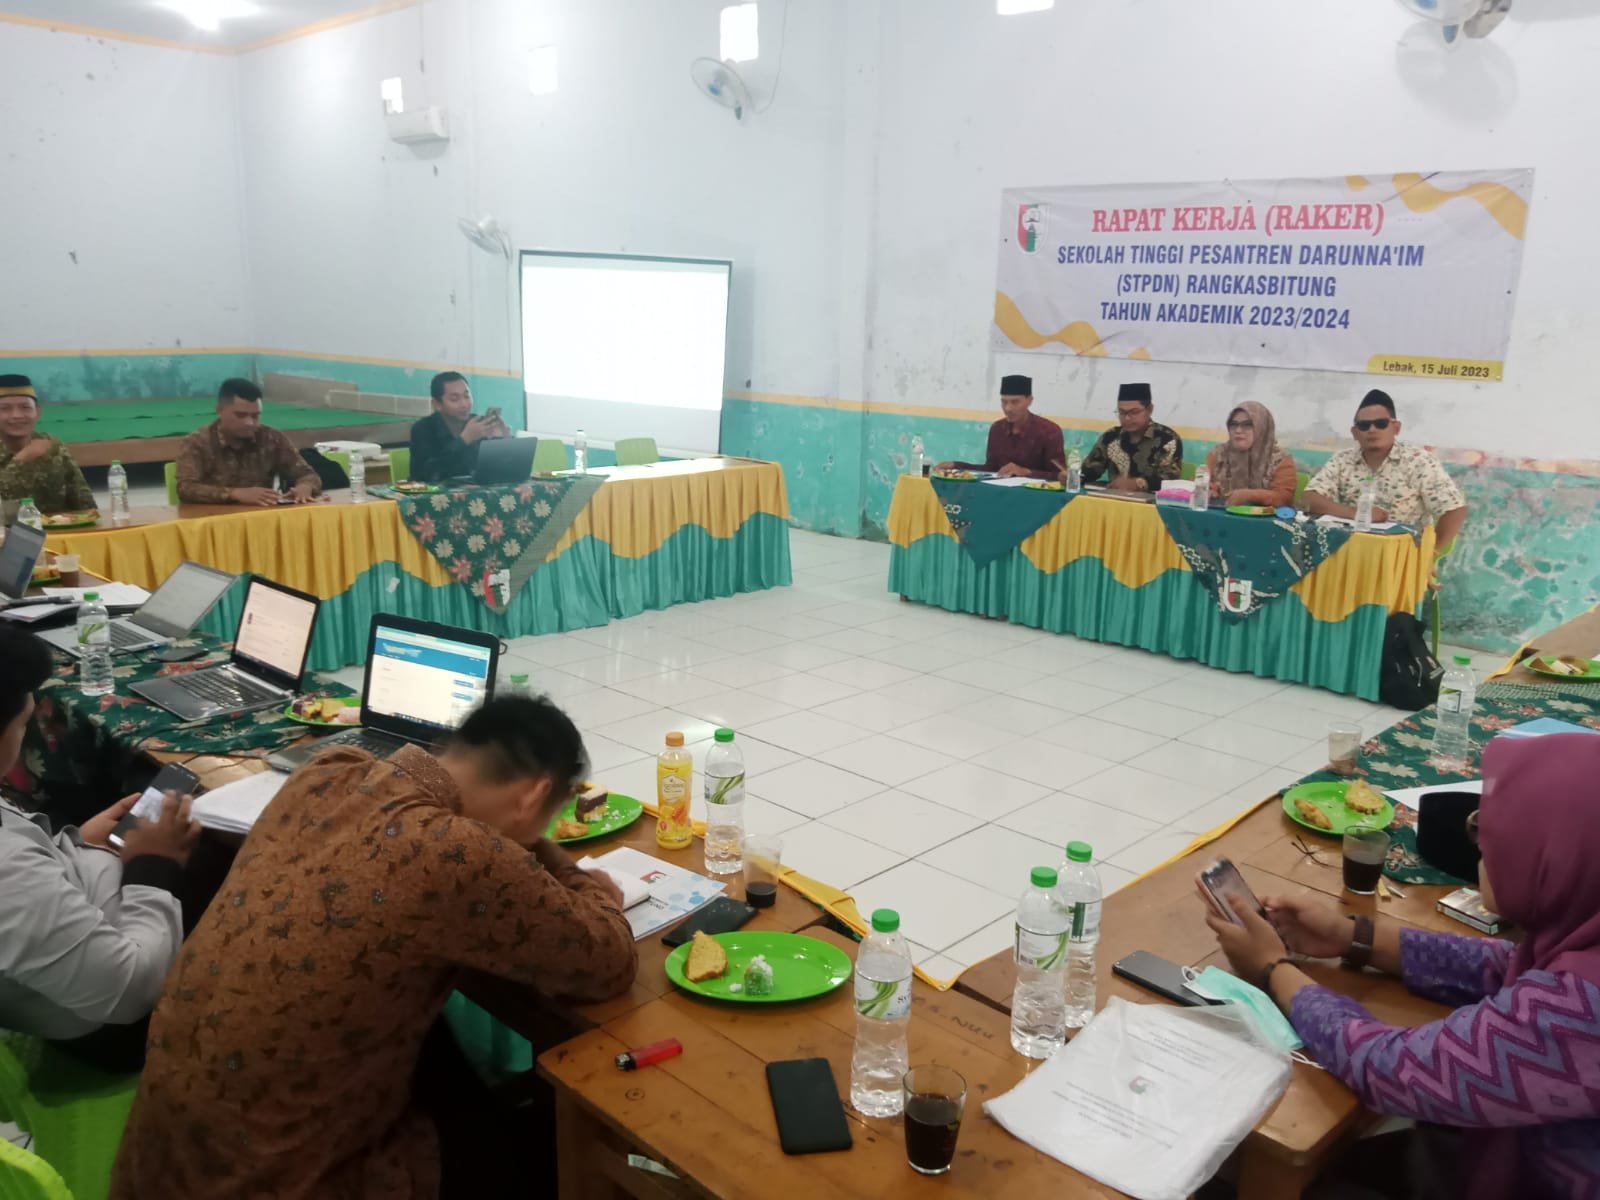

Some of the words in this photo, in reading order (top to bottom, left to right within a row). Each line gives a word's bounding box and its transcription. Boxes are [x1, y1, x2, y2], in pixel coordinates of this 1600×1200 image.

[1091, 207, 1166, 233] RAPAT
[1172, 206, 1257, 232] KERJA
[1265, 203, 1384, 236] (RAKER)
[1057, 245, 1124, 264] SEKOLAH
[1131, 245, 1183, 264] TINGGI
[1189, 244, 1292, 265] PESANTREN
[1299, 245, 1425, 266] DARUNNA'IM
[1117, 274, 1180, 297] (STPDN)
[1186, 275, 1337, 297] RANGKASBITUNG
[1100, 302, 1151, 321] TAHUN
[1156, 304, 1244, 325] AKADEMIK
[1249, 306, 1350, 329] 2023/2024
[1383, 360, 1416, 374] Lebak,
[1421, 363, 1434, 374] 15
[1437, 364, 1458, 376] Juli
[1460, 366, 1490, 378] 2023
